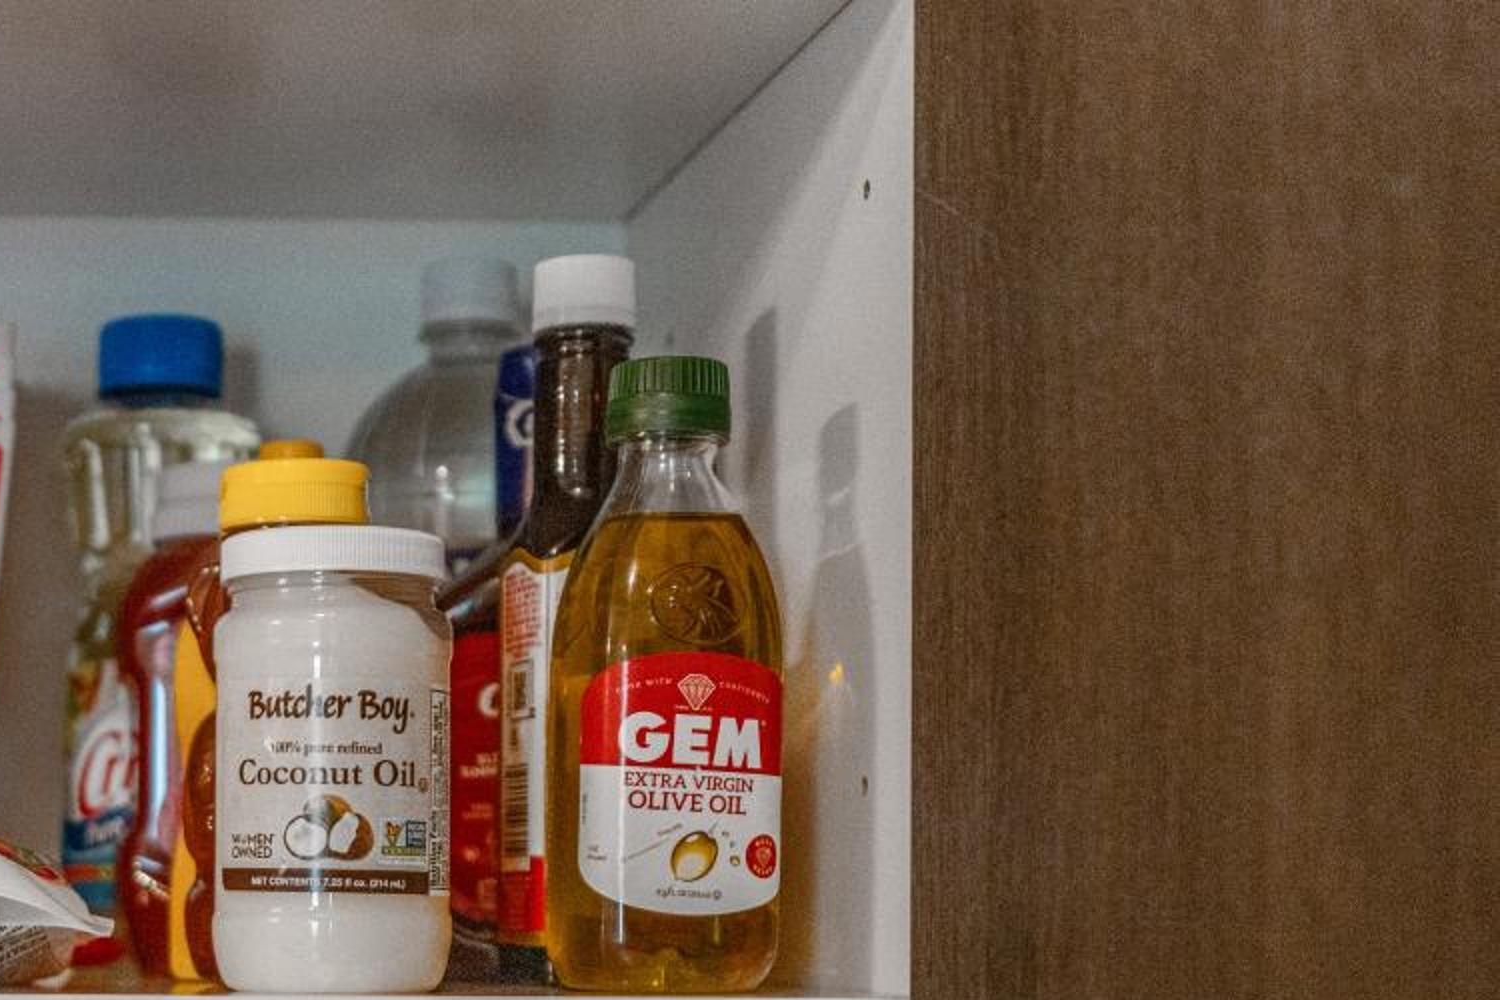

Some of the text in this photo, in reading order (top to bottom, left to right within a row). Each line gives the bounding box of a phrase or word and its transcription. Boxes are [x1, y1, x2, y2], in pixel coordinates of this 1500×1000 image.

[248, 684, 352, 720] Butcher
[618, 711, 762, 768] GEM
[239, 759, 416, 787] Coconut Oil
[624, 771, 754, 793] EXTRA VIRGIN
[628, 790, 748, 816] OLIVE OIL
[231, 846, 273, 859] OWNED
